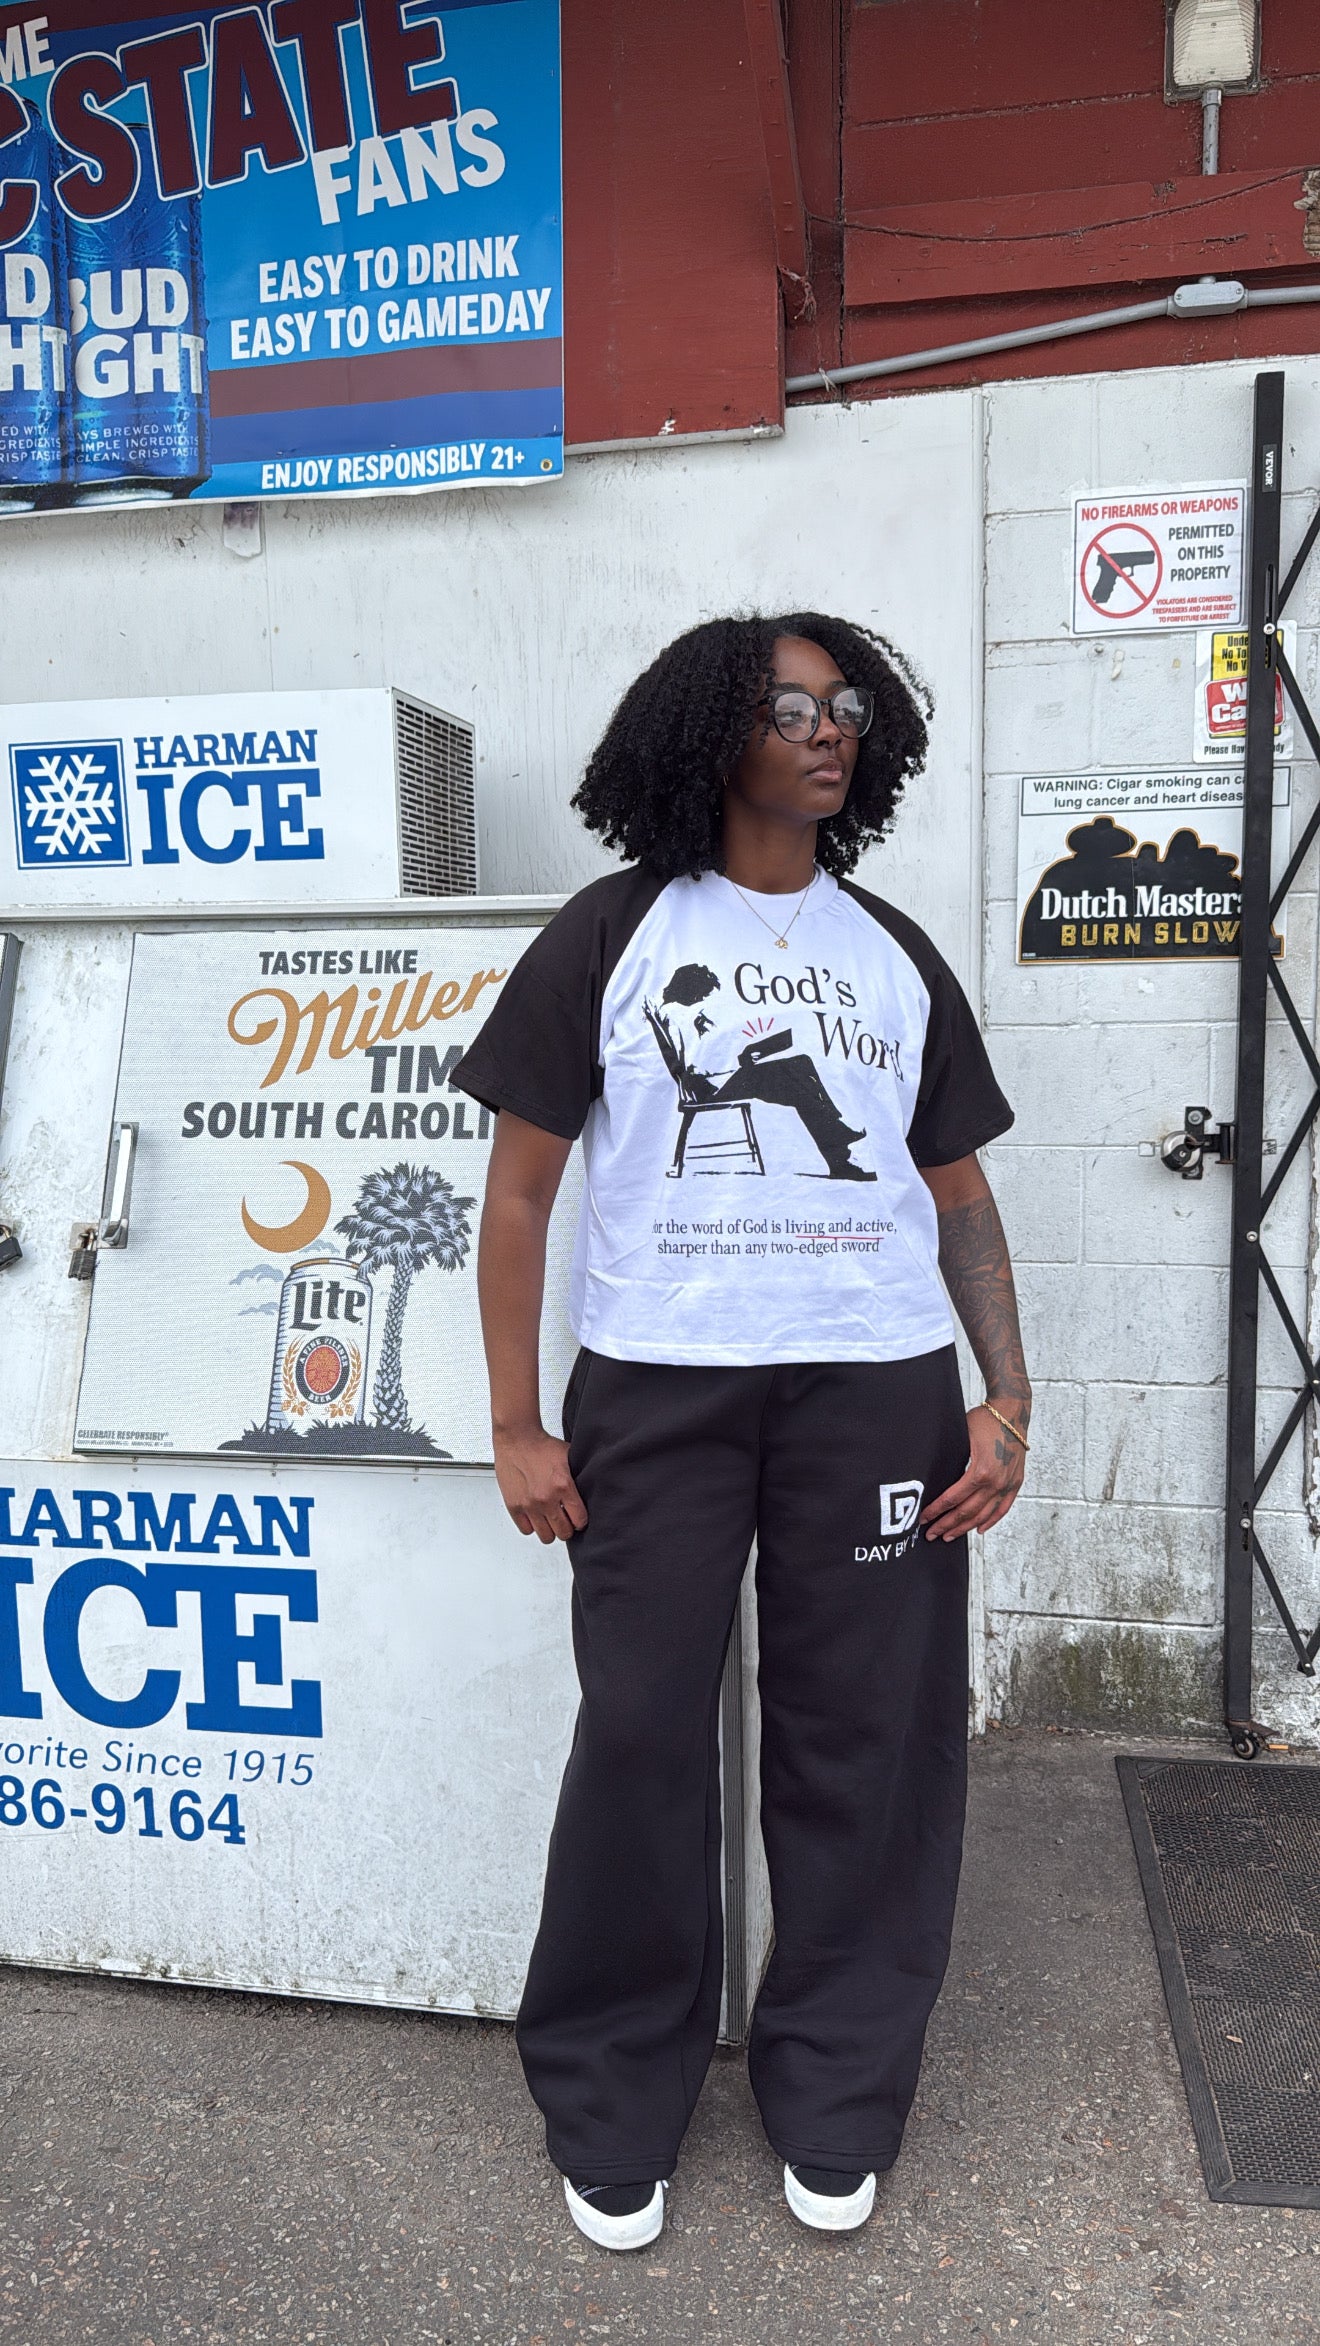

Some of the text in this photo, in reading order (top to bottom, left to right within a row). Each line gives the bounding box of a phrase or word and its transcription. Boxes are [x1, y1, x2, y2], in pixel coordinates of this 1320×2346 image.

[47, 0, 459, 223] STATE
[312, 109, 505, 226] FANS
[259, 235, 520, 302] EASY TO DRINK
[231, 288, 552, 360] EASY TO GAMEDAY
[103, 424, 159, 438] BREWED
[80, 440, 121, 452] IMPLE
[129, 449, 168, 460] CRISP
[261, 443, 525, 489] ENJOY RESPONSIBLY 21+
[1265, 450, 1274, 486] VEVOR
[1081, 497, 1239, 521] NO FIREARMS OR WEAPONS
[1168, 523, 1234, 541] PERMITTED
[1178, 545, 1224, 560] ON THIS
[1170, 565, 1231, 582] PROPERTY
[1222, 648, 1233, 659] No
[1228, 635, 1249, 646] Unde
[1227, 660, 1238, 672] No
[134, 729, 318, 769] HARMAN
[1204, 744, 1245, 755] Please Hav
[1033, 779, 1103, 792] WARNING:
[1107, 778, 1141, 791] Cigar
[1145, 775, 1203, 790] smoking
[1206, 775, 1230, 785] can
[1054, 790, 1243, 809] lung cancer and heart diseas
[137, 767, 325, 864] ICE
[1040, 886, 1128, 920] Dutch
[1061, 920, 1240, 946] BURN SLOW
[259, 949, 418, 975] TASTES LIKE
[734, 962, 857, 1008] God's
[228, 969, 507, 1089] Miller
[364, 1045, 464, 1093] TIM
[182, 1101, 490, 1140] SOUTH CAROLI
[666, 1219, 688, 1234] the
[691, 1219, 723, 1234] word
[727, 1219, 743, 1234] of
[743, 1219, 768, 1234] God
[771, 1219, 781, 1234] is
[785, 1218, 825, 1237] living
[828, 1218, 852, 1233] and
[855, 1219, 898, 1235] active,
[657, 1238, 880, 1258] sharper than any two-edged sword
[289, 1280, 366, 1331] Lite
[855, 1544, 892, 1562] DAY
[0, 1737, 315, 1786] orite Since 1915
